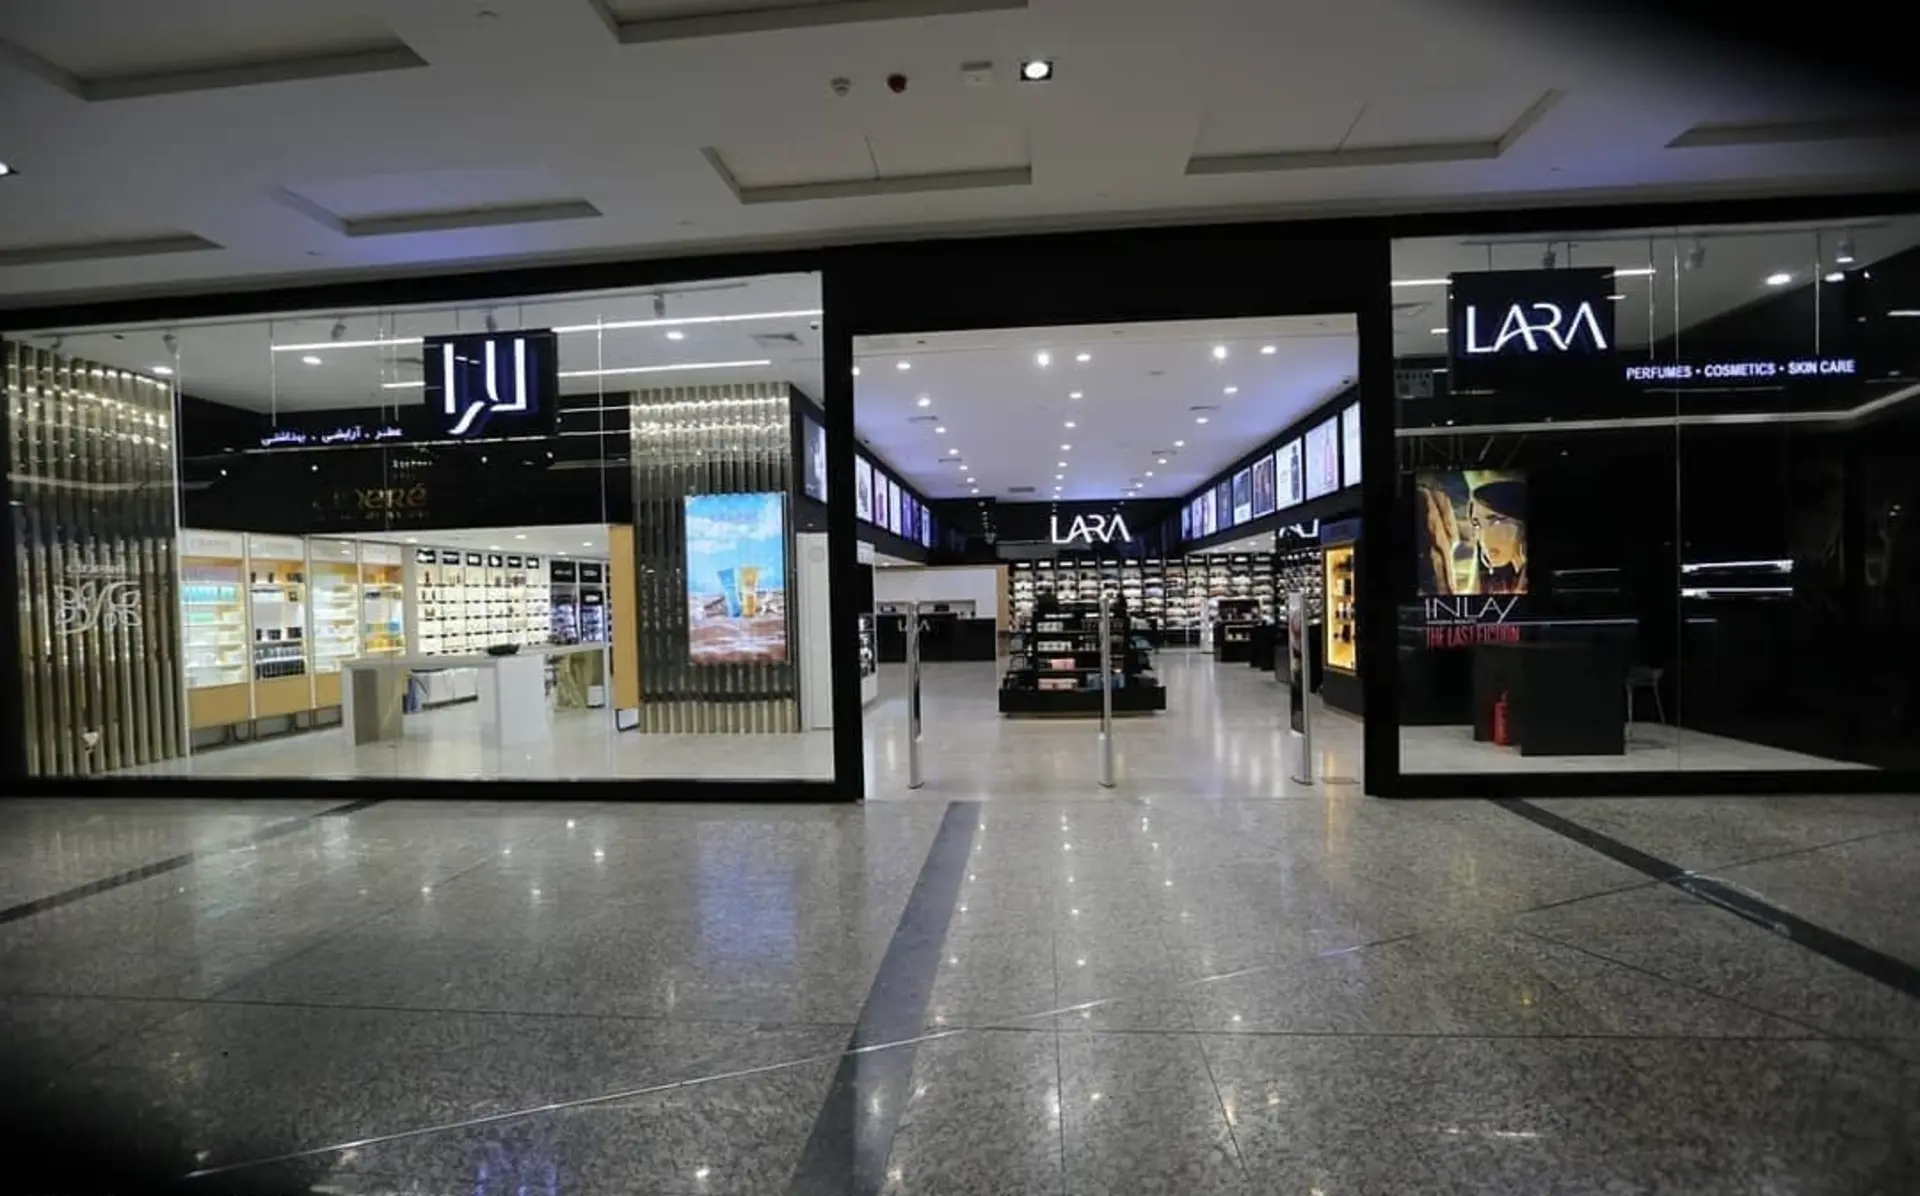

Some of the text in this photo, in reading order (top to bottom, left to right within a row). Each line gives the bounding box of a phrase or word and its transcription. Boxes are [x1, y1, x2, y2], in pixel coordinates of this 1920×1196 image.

[1467, 302, 1606, 352] LARA
[1626, 359, 1855, 381] PERFUMES COSMETICS SKIN CARE
[444, 337, 526, 435] لارا
[1052, 514, 1131, 543] LARA
[1425, 596, 1519, 625] INLAY
